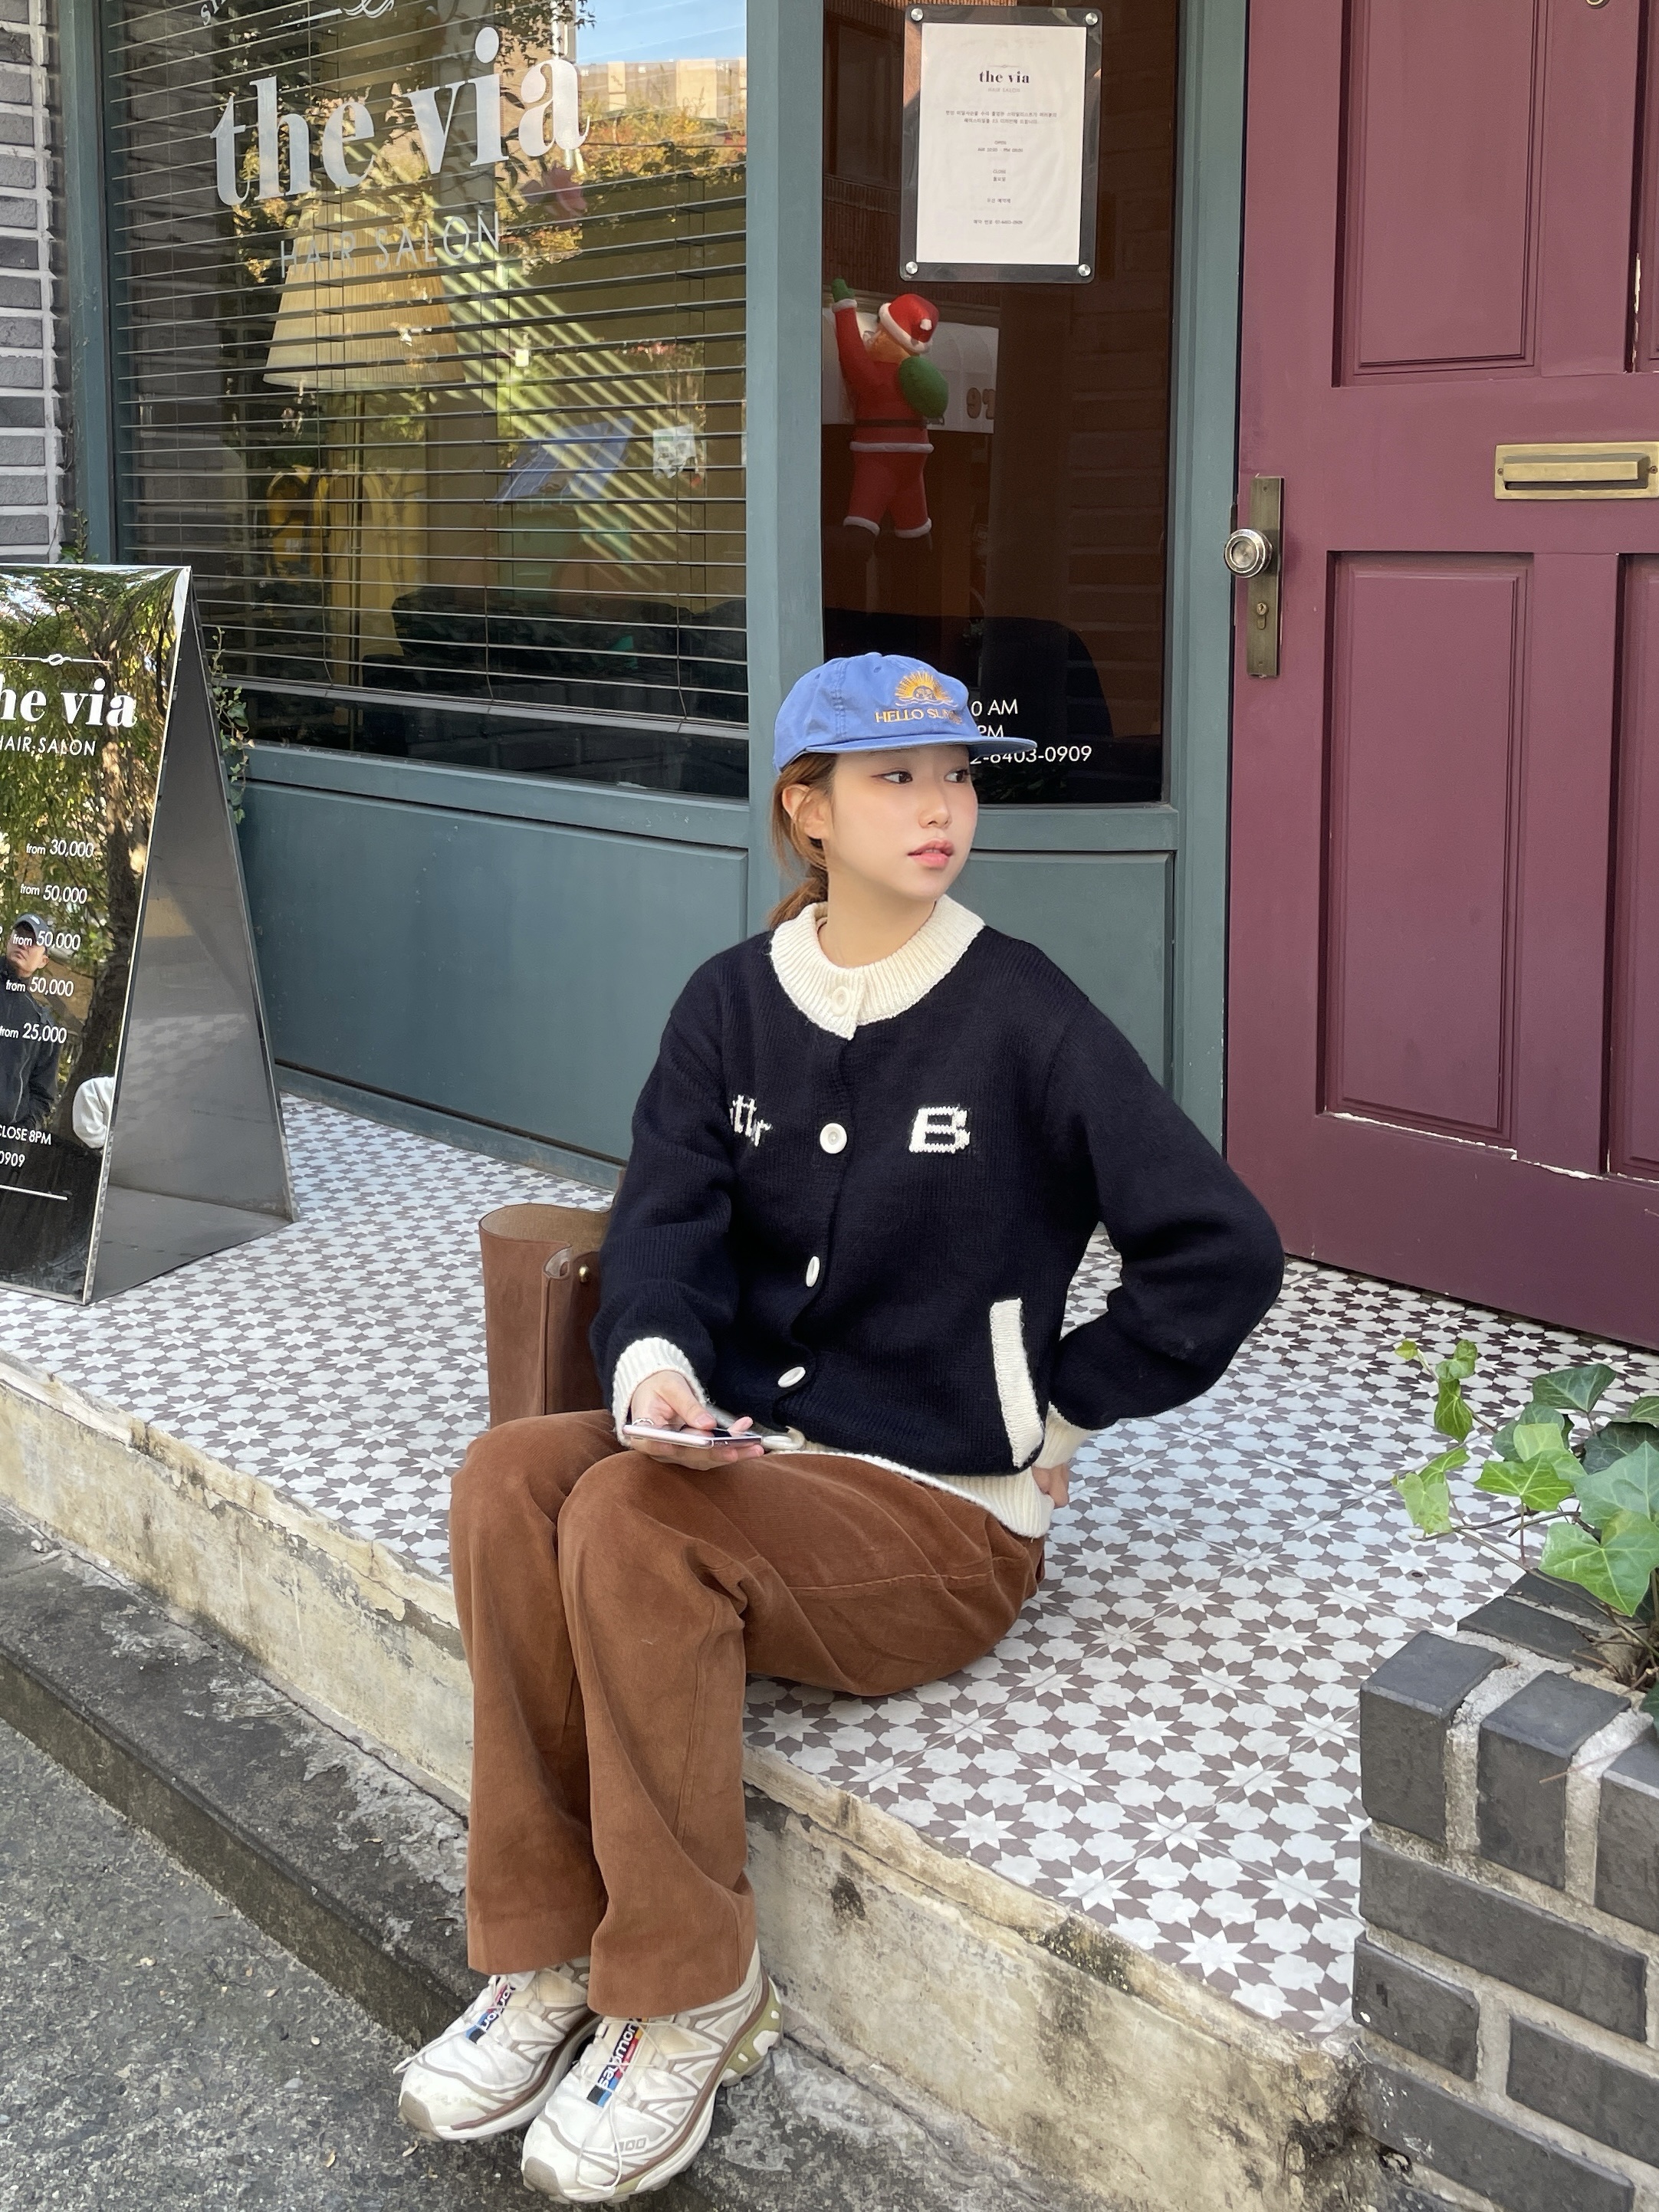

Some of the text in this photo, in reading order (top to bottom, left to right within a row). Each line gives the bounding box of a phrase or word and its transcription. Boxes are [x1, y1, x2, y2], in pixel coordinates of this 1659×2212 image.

[979, 71, 1030, 84] the via
[210, 27, 590, 205] the via
[280, 209, 501, 278] HAIR SALON
[61, 678, 138, 728] via
[987, 698, 1018, 716] AM
[875, 708, 925, 723] HELLO
[38, 737, 96, 756] SALON
[26, 839, 94, 858] from 30,000
[20, 884, 88, 904] from 50,000
[12, 934, 32, 947] from
[36, 930, 81, 950] 50,000
[5, 976, 74, 997] from 50,000
[0, 1022, 67, 1044] from 25,000
[28, 1131, 51, 1145] 8PM
[909, 1104, 971, 1154] B
